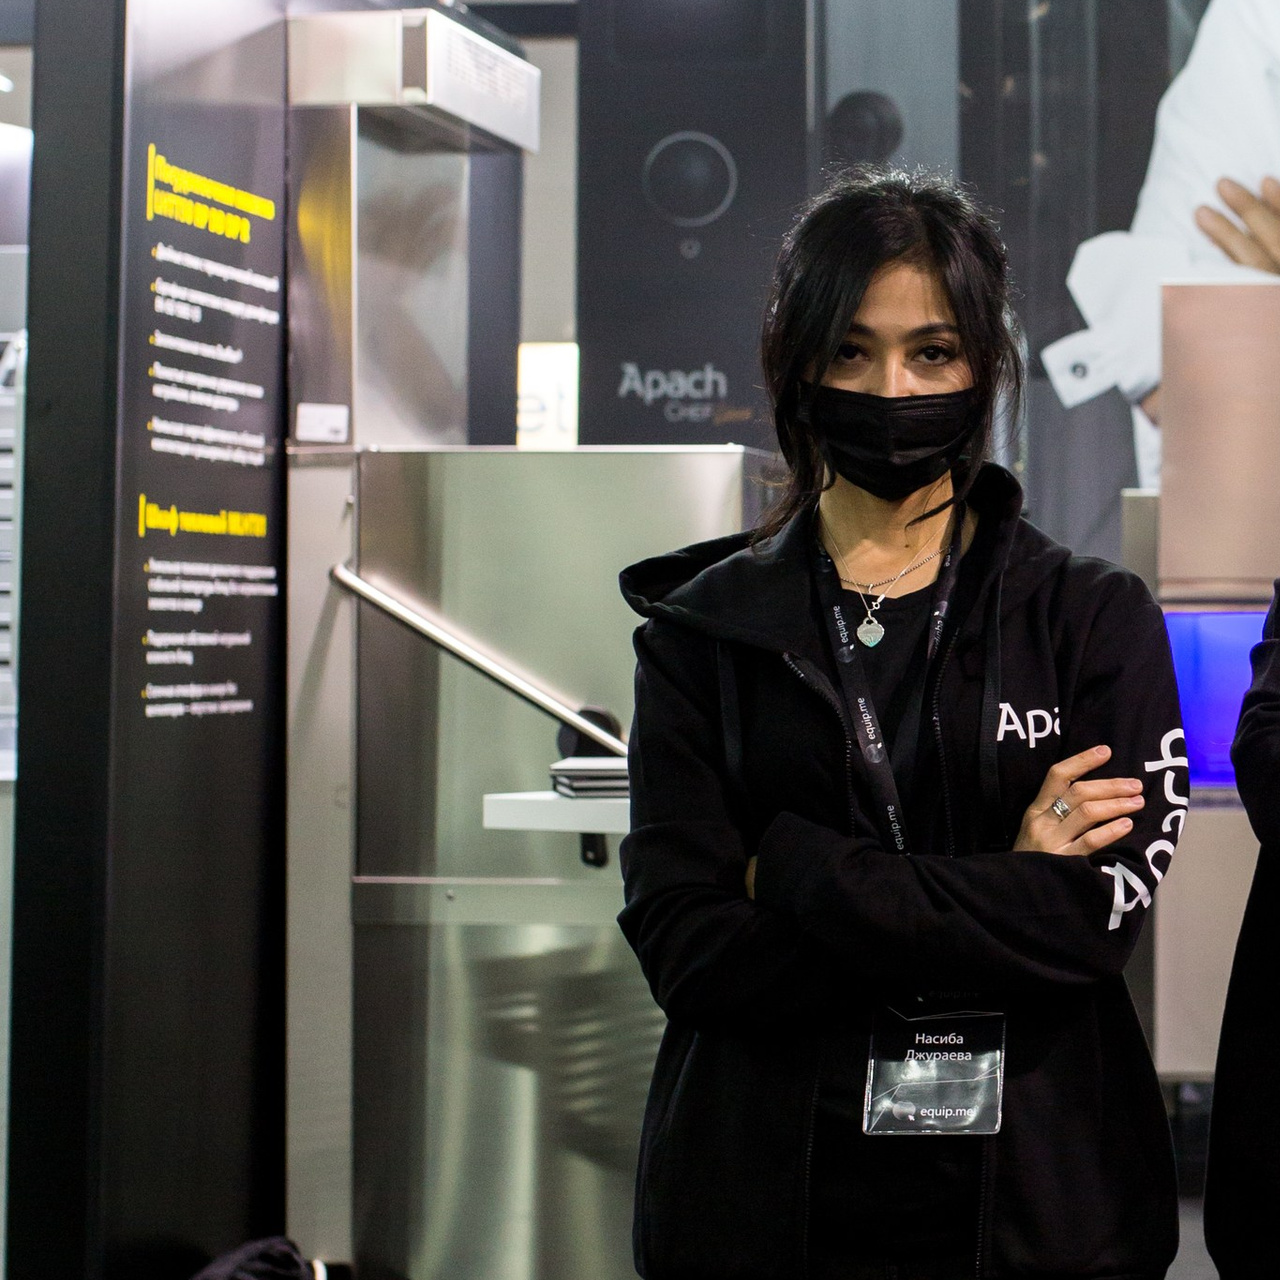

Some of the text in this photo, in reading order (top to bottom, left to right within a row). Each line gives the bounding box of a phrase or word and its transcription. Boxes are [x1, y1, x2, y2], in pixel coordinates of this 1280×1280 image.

[617, 361, 729, 407] Apach
[833, 605, 849, 644] equip.me
[857, 697, 876, 740] equip.me
[887, 805, 905, 850] equip.me
[904, 1049, 972, 1064] Джураева
[915, 1032, 964, 1045] Насиба
[920, 1105, 974, 1119] equip.me
